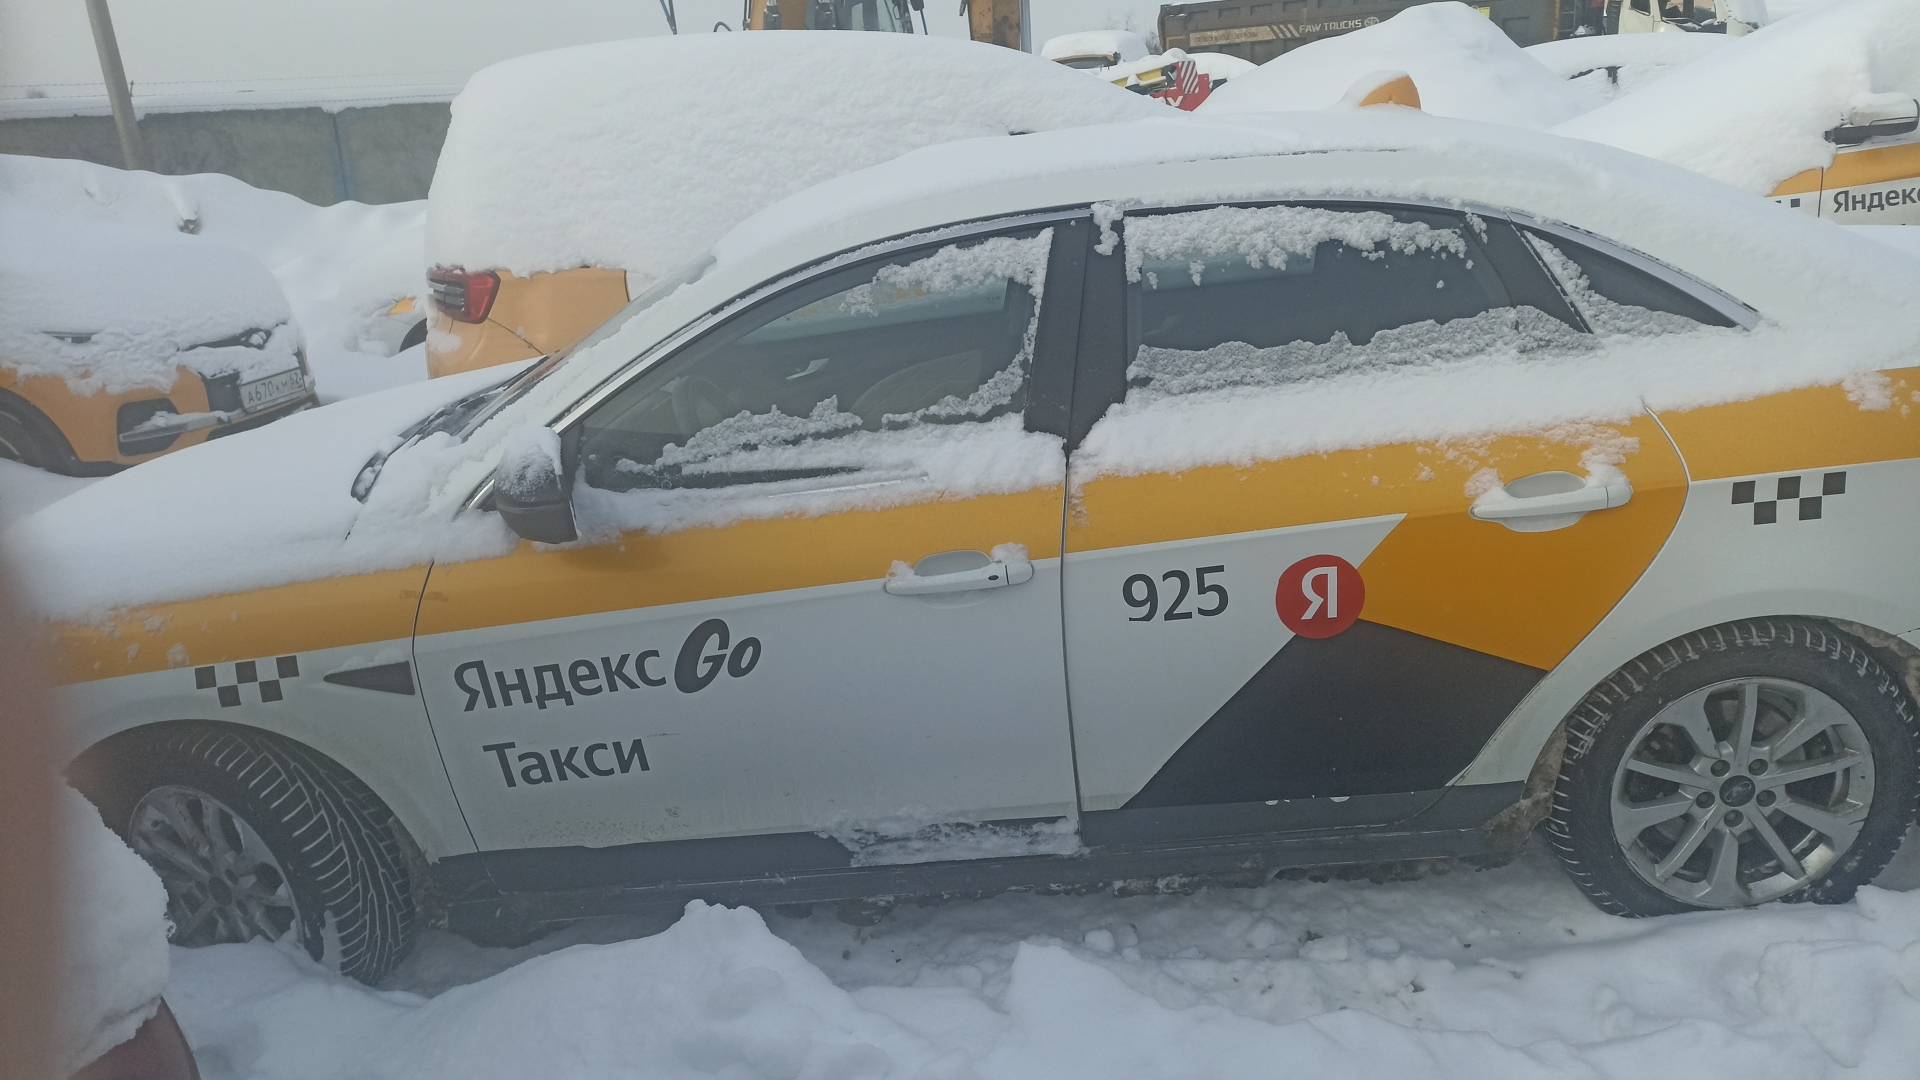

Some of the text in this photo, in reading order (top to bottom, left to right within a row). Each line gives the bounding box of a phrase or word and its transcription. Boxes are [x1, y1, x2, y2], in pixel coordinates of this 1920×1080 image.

[1299, 18, 1362, 34] FAW TRUCKS
[1833, 187, 1920, 213] Яндек
[1122, 564, 1229, 622] 925
[1300, 566, 1338, 620] Я
[453, 618, 762, 712] Яндекс Go
[482, 738, 650, 788] Такси
